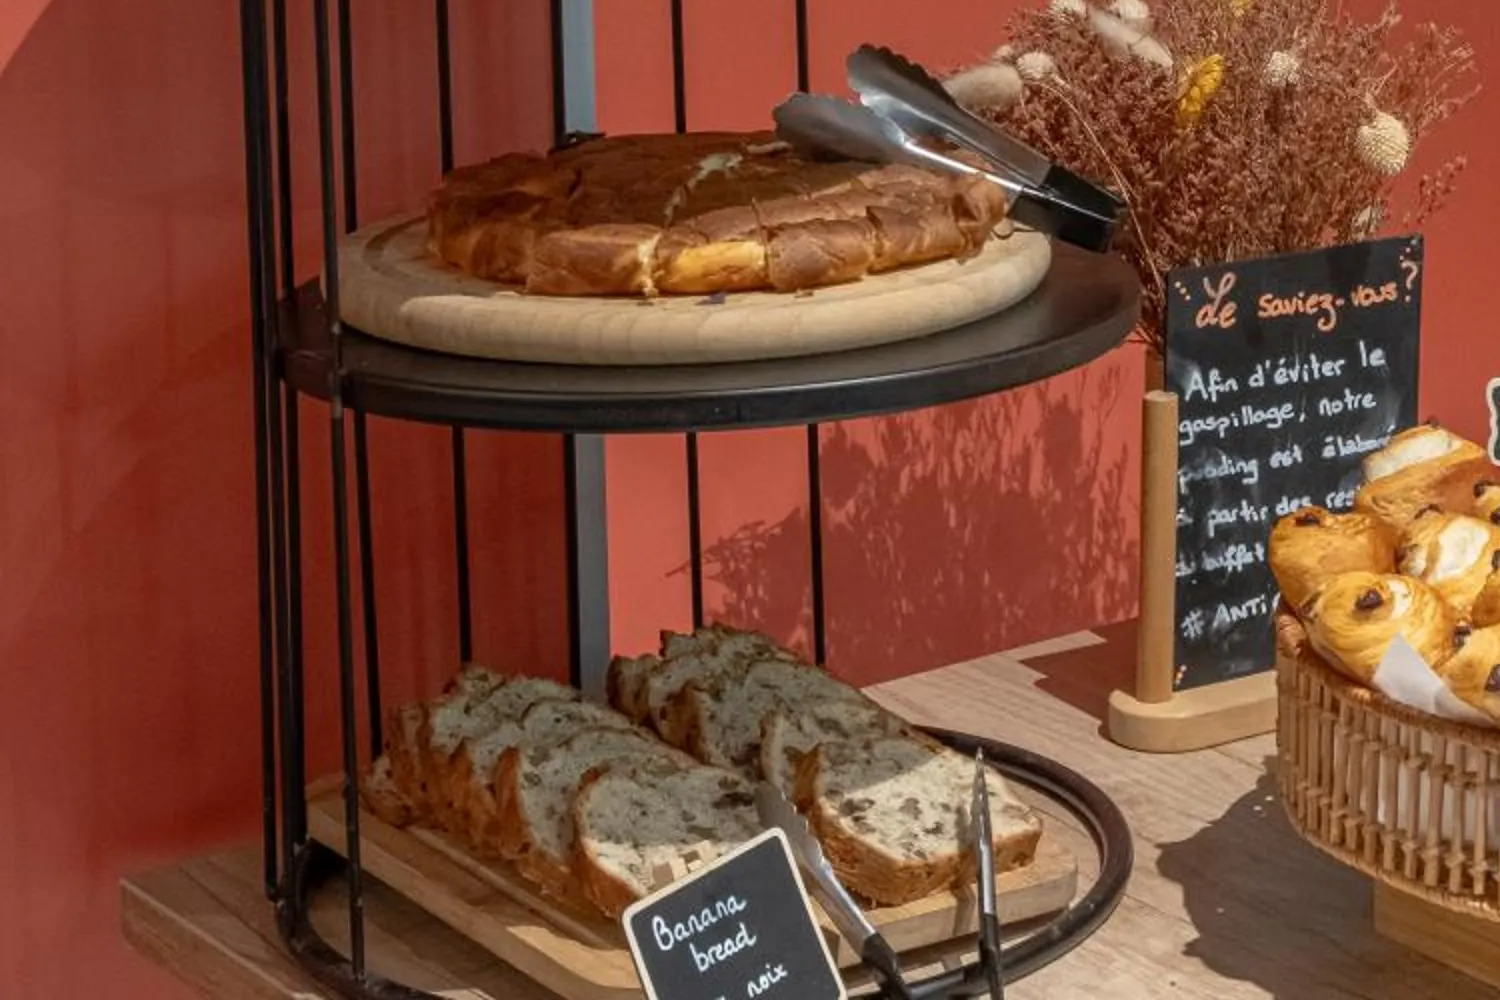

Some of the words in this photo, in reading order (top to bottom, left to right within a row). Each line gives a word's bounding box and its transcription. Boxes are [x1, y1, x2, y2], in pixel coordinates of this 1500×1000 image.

[1195, 272, 1237, 328] Le
[1184, 368, 1239, 403] Afin
[1247, 353, 1346, 388] d'éviter
[1359, 340, 1386, 368] le
[1319, 388, 1377, 417] notre
[1207, 499, 1269, 538] partir
[652, 895, 747, 951] Banana
[690, 922, 757, 973] bread
[747, 963, 788, 998] noix
